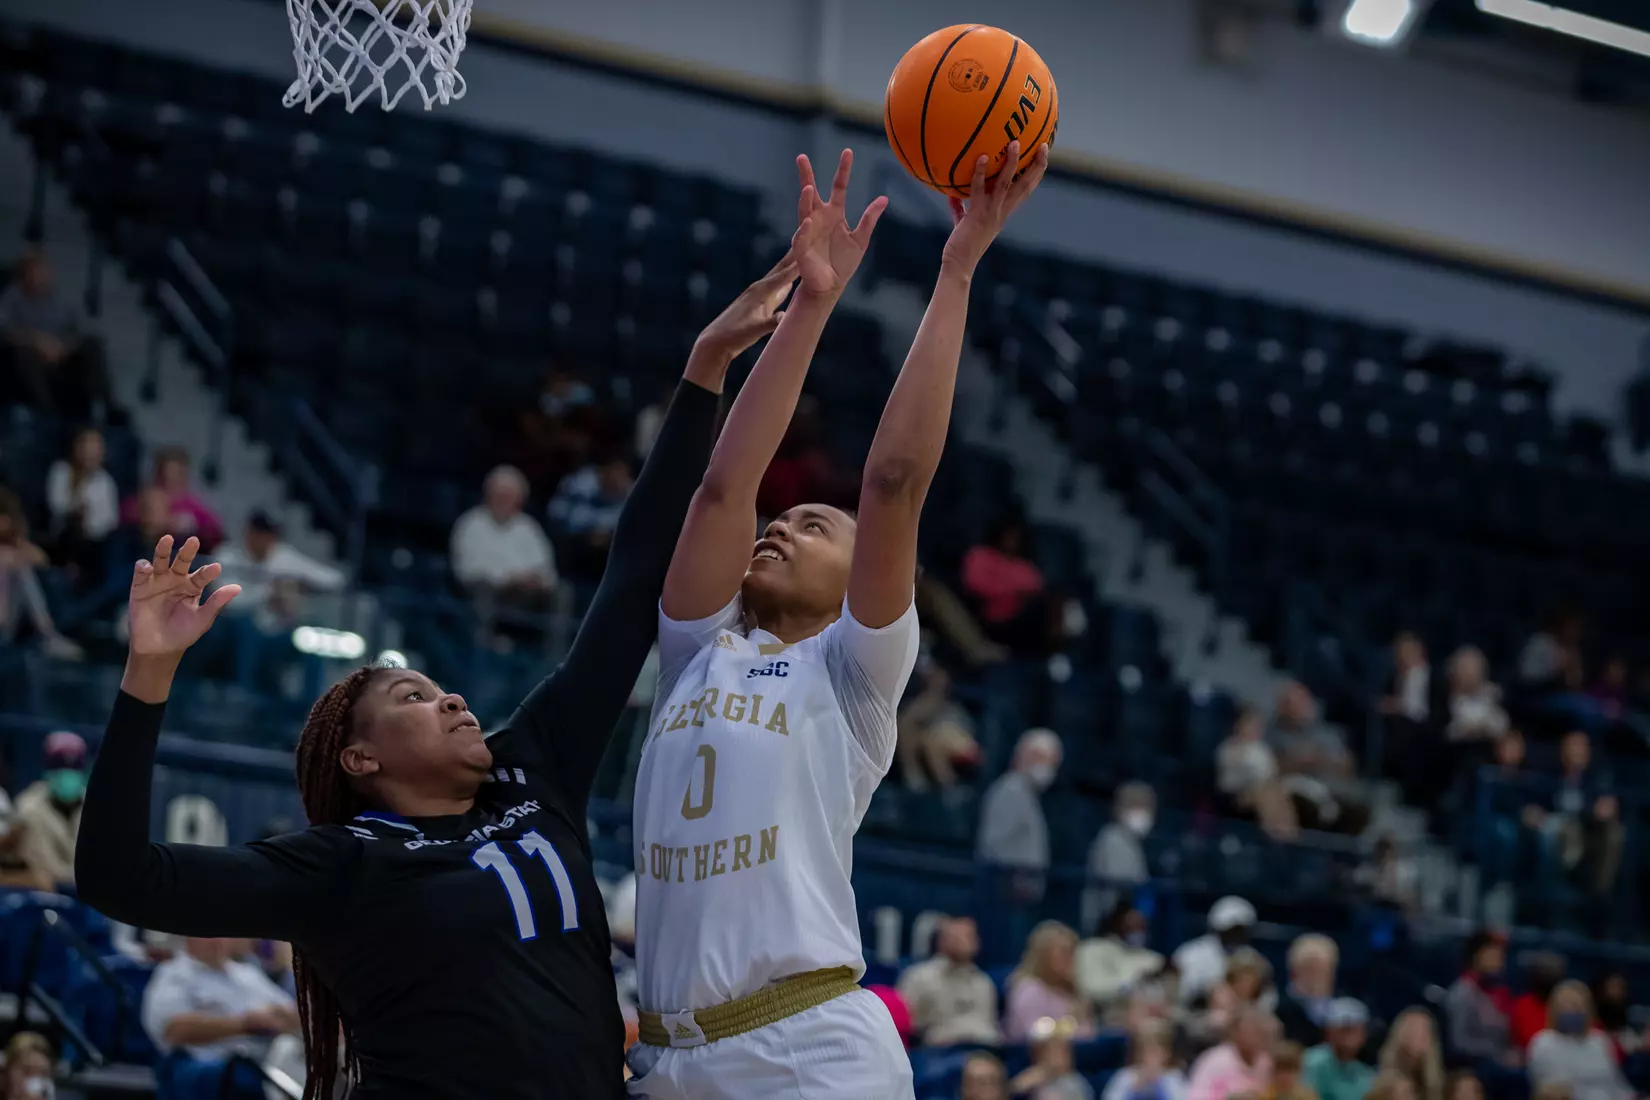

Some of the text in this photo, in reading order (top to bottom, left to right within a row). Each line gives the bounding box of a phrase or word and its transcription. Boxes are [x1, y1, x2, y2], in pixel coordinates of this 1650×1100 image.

[1003, 72, 1042, 142] EVO
[746, 661, 790, 679] SBC
[653, 687, 790, 741] ERGIA
[680, 743, 717, 821] 0
[470, 827, 581, 943] 11
